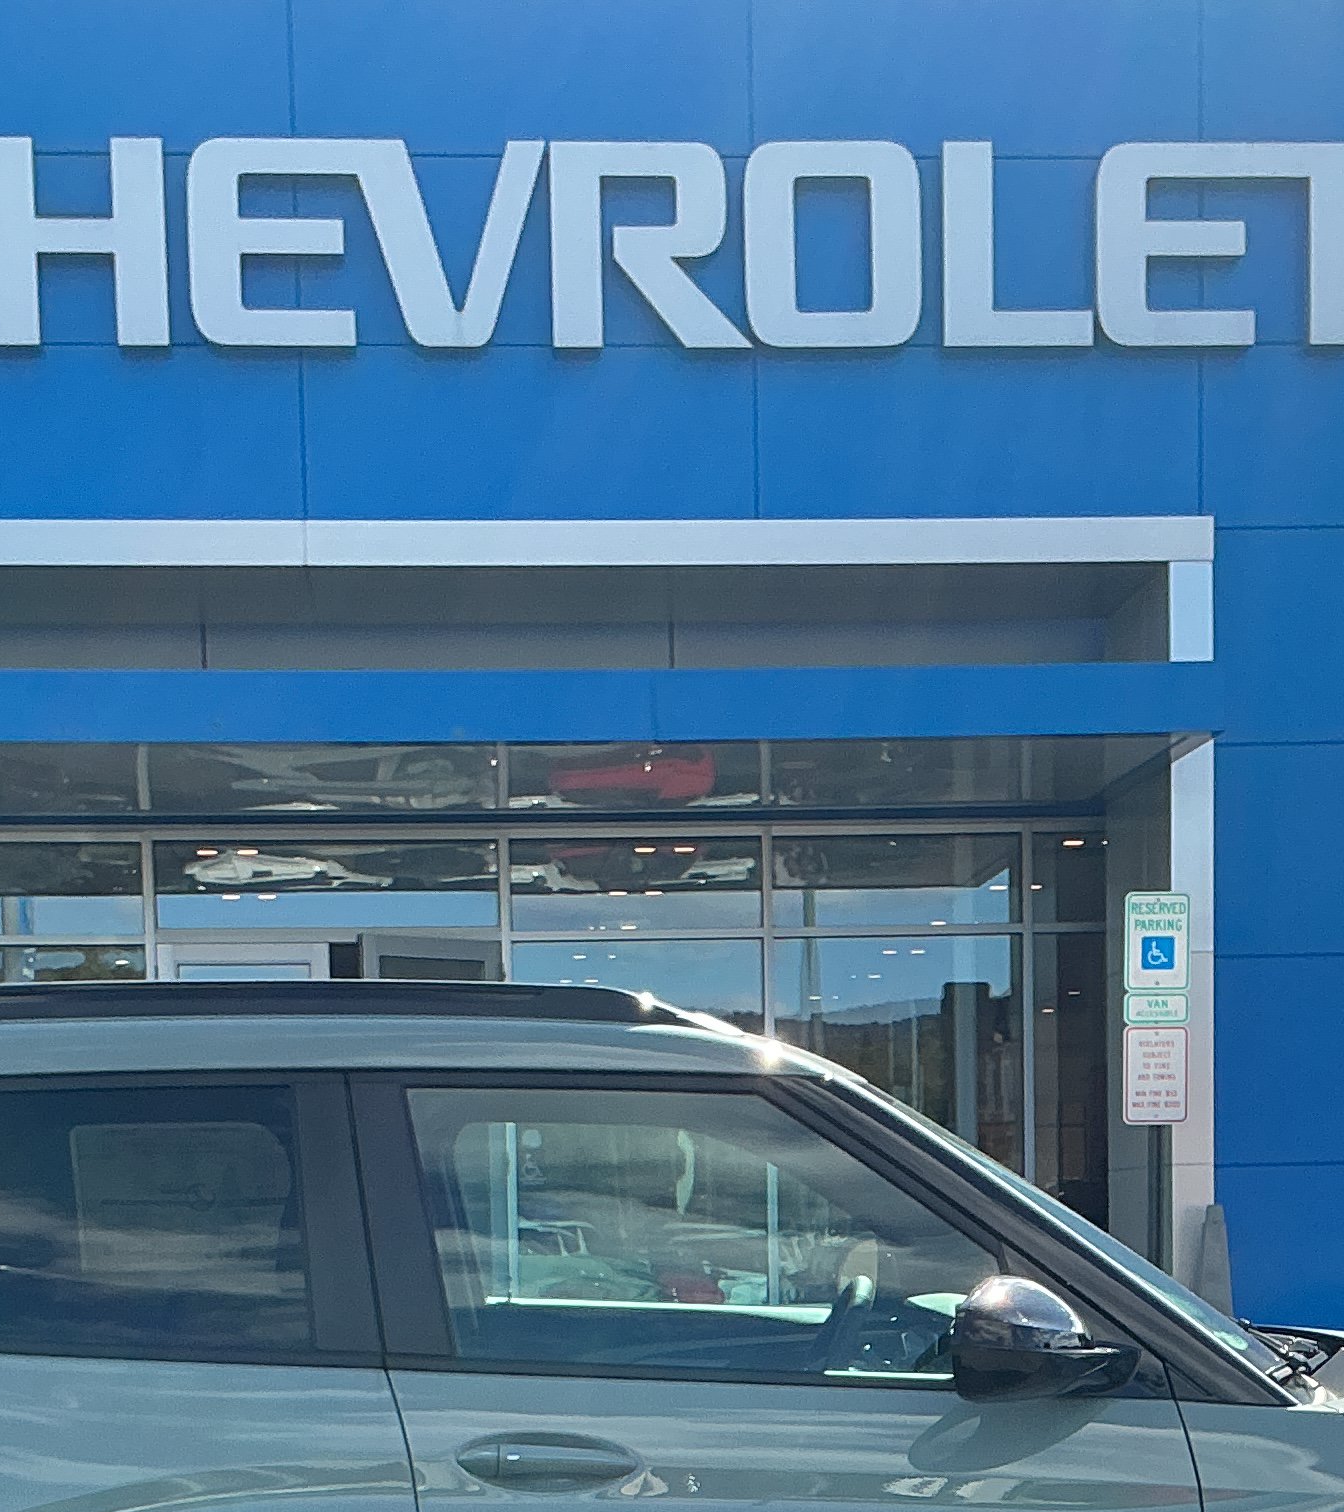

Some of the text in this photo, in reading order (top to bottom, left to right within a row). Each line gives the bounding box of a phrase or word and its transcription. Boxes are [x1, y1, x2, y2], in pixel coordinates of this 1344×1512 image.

[1130, 901, 1187, 916] RESERVED
[1134, 918, 1183, 932] PARKING
[1146, 999, 1169, 1009] VAN
